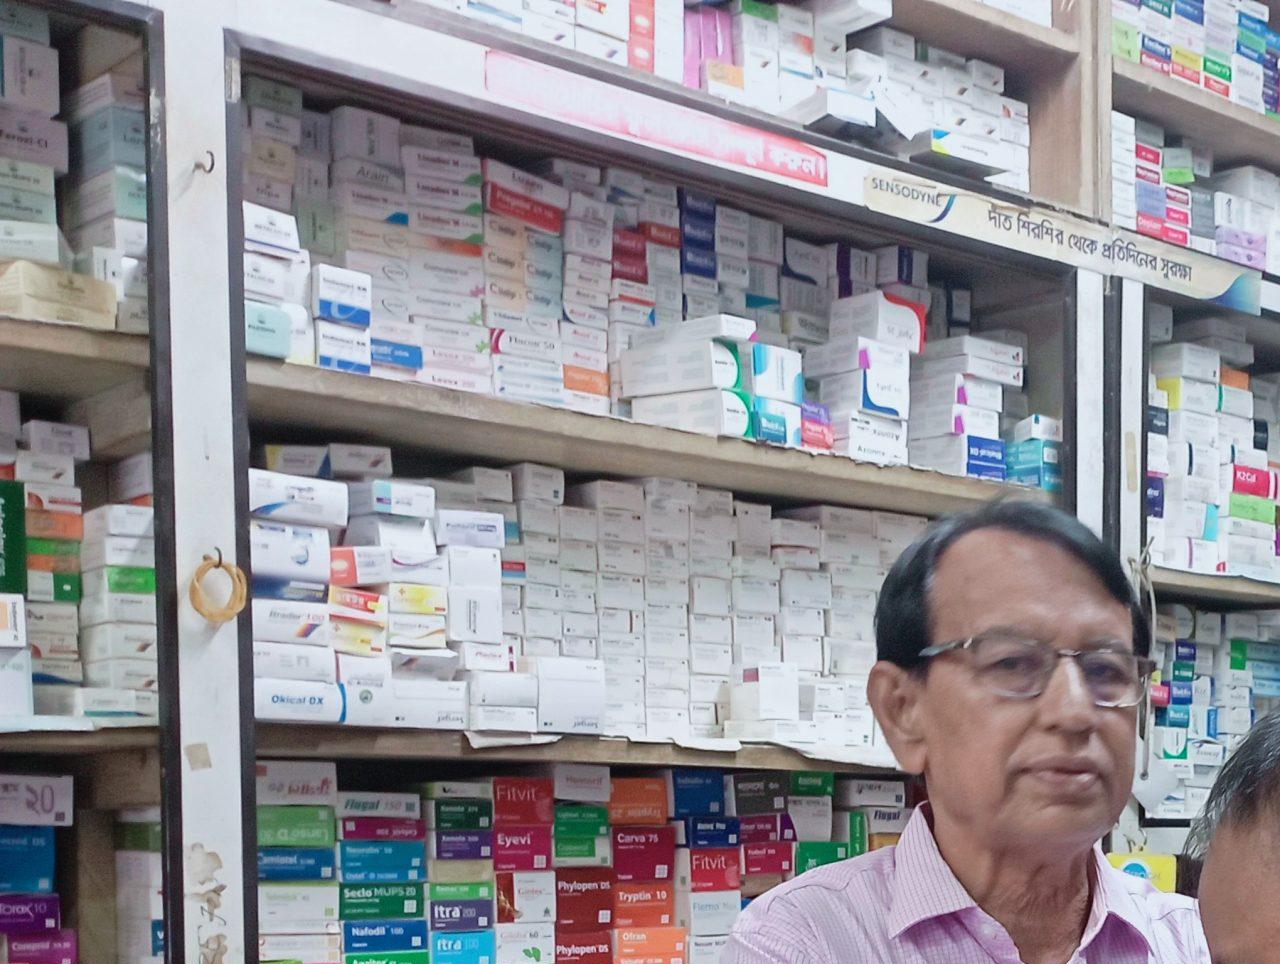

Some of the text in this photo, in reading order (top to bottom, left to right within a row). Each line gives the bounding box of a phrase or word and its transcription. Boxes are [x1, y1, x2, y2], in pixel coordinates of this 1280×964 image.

[872, 178, 942, 207] SENSODYNE
[1069, 233, 1098, 256] থেকে
[308, 696, 324, 706] DX
[496, 784, 537, 801] Fitvit
[498, 833, 532, 848] Eyevi
[618, 834, 646, 844] Carva
[693, 856, 727, 870] Fitvit
[343, 888, 373, 900] Seclo
[619, 891, 667, 903] Tryptin 10
[434, 904, 461, 919] Itra
[352, 928, 387, 939] Nafodil
[622, 932, 648, 942] Ofran
[437, 937, 462, 951] Itra
